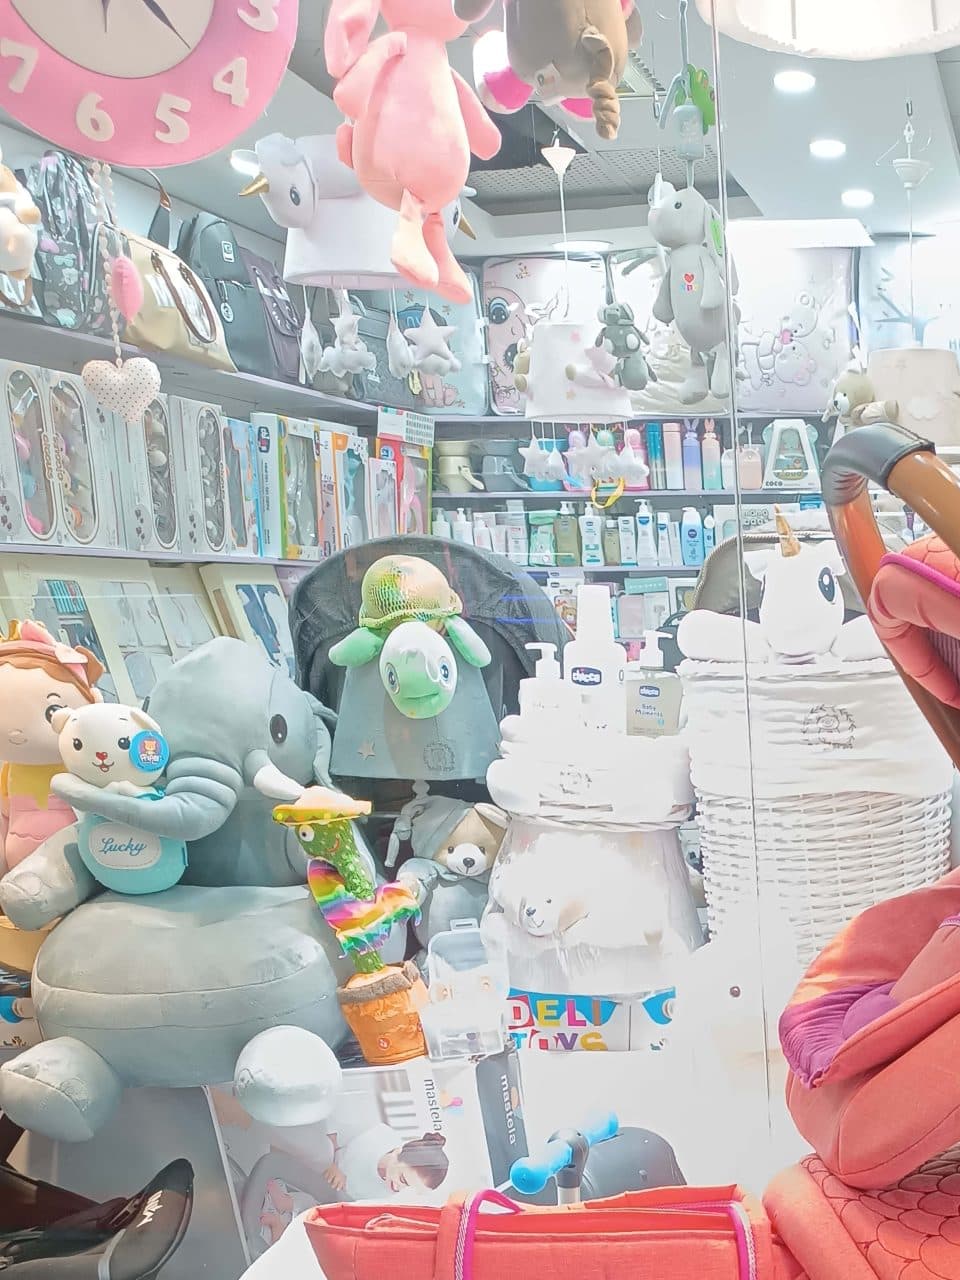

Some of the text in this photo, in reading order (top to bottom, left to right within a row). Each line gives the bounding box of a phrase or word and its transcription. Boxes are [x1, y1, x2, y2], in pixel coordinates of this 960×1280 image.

[0, 38, 39, 93] 7
[212, 56, 250, 107] 4
[75, 92, 115, 142] 6
[154, 92, 192, 143] 5
[100, 837, 148, 857] Lucky
[424, 1078, 442, 1131] mastela
[501, 1075, 517, 1145] mastela
